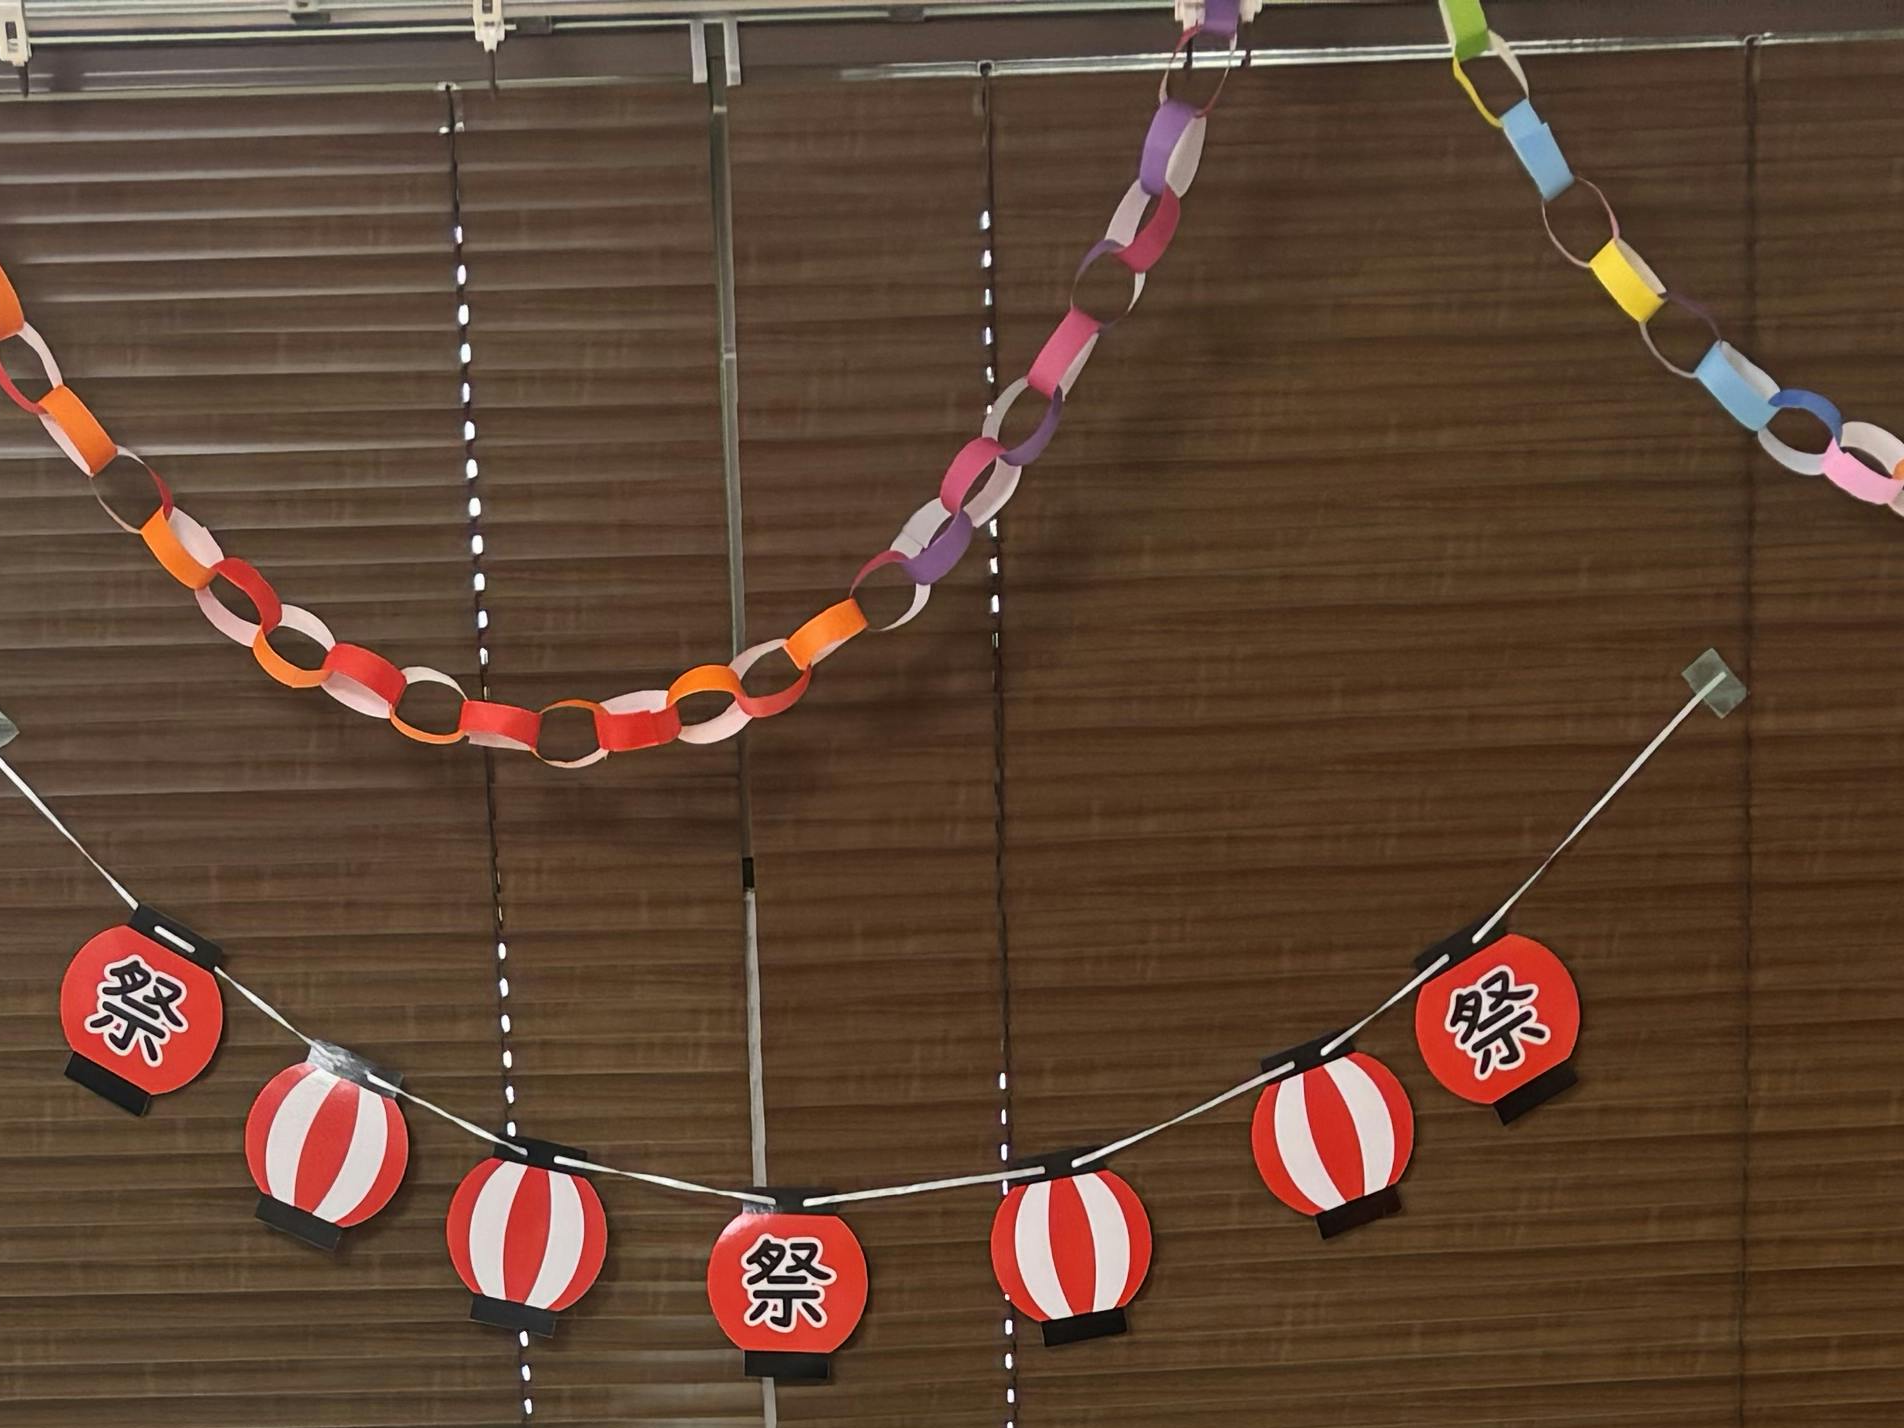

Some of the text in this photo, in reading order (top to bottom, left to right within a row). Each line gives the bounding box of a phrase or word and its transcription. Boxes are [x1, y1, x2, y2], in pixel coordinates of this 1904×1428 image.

[87, 953, 187, 1066] 祭
[1445, 966, 1550, 1079] 祭
[743, 1235, 836, 1332] 祭
